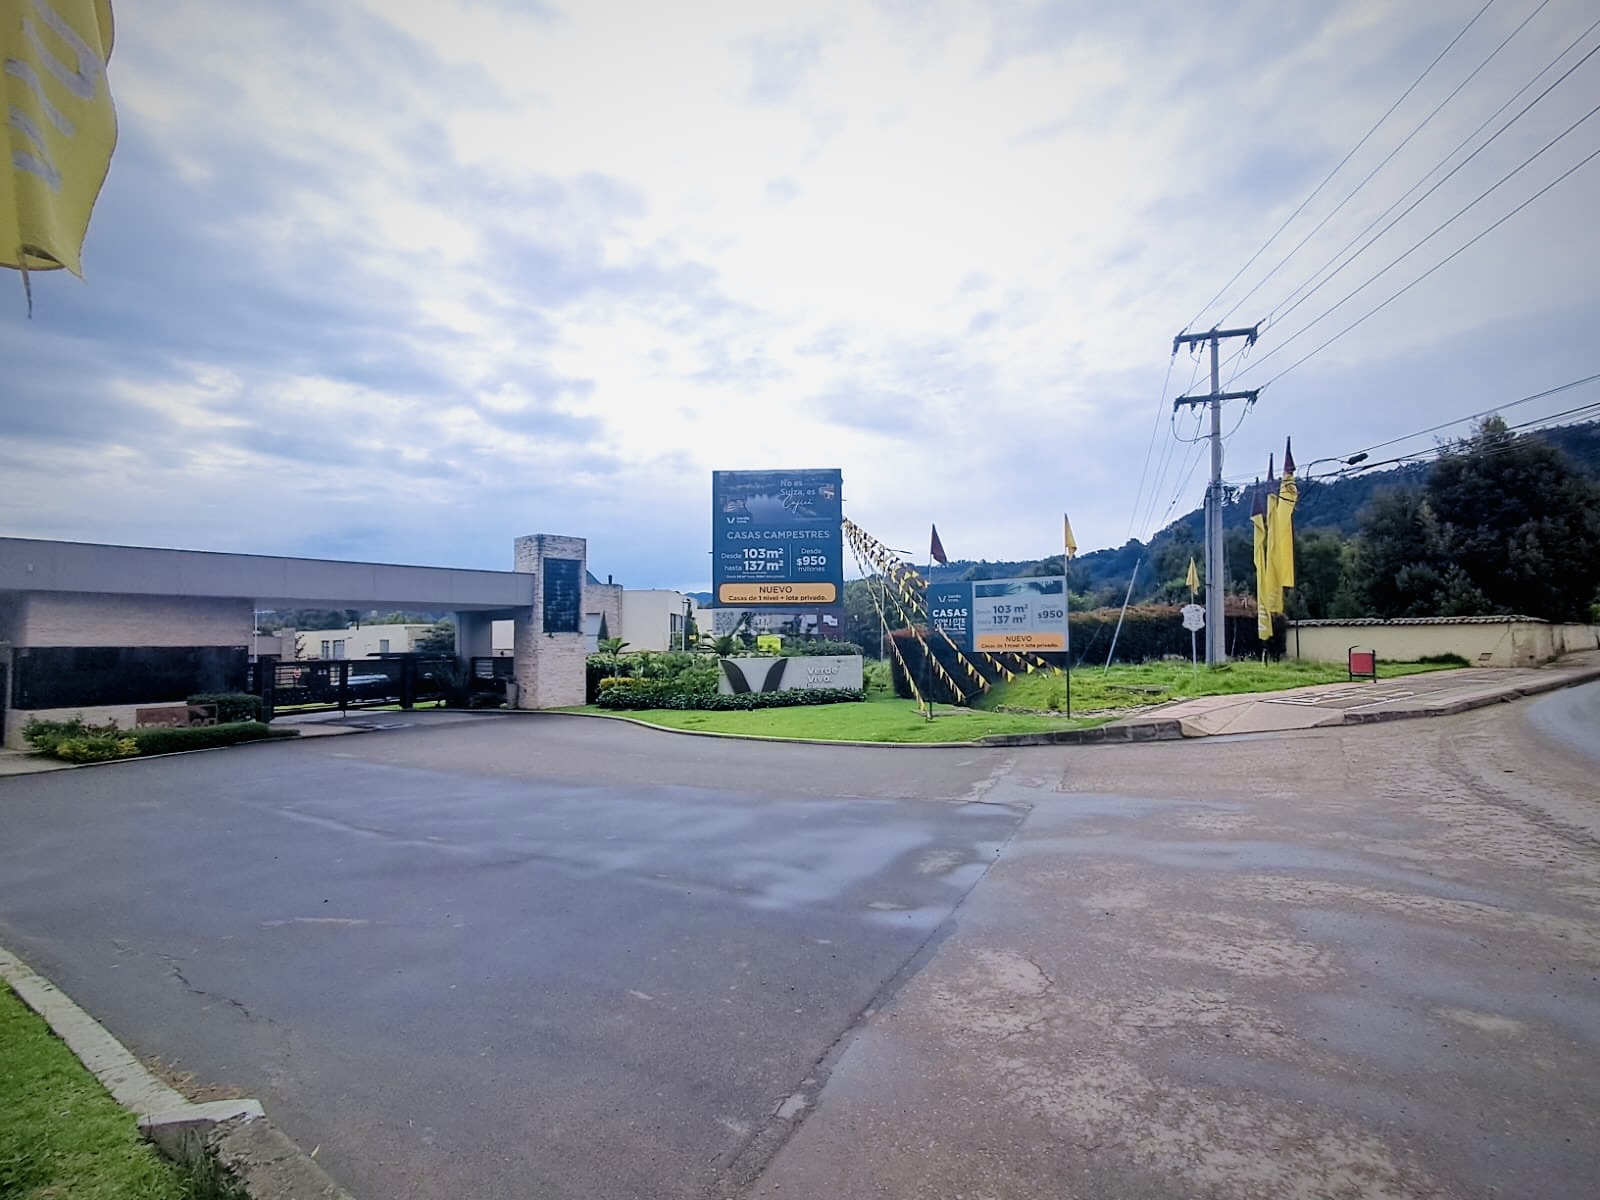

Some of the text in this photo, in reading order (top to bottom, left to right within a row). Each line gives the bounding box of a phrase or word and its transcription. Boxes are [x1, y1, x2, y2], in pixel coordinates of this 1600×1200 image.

[780, 479, 792, 488] No
[726, 530, 831, 540] CASAS CAMPESTRES
[720, 552, 742, 560] Desde
[796, 556, 827, 566] $950
[759, 586, 793, 594] NUEVO
[932, 608, 968, 617] CASAS
[992, 605, 1011, 614] 103
[1037, 610, 1064, 619] $950
[992, 615, 1010, 624] 137
[808, 666, 838, 674] Verde
